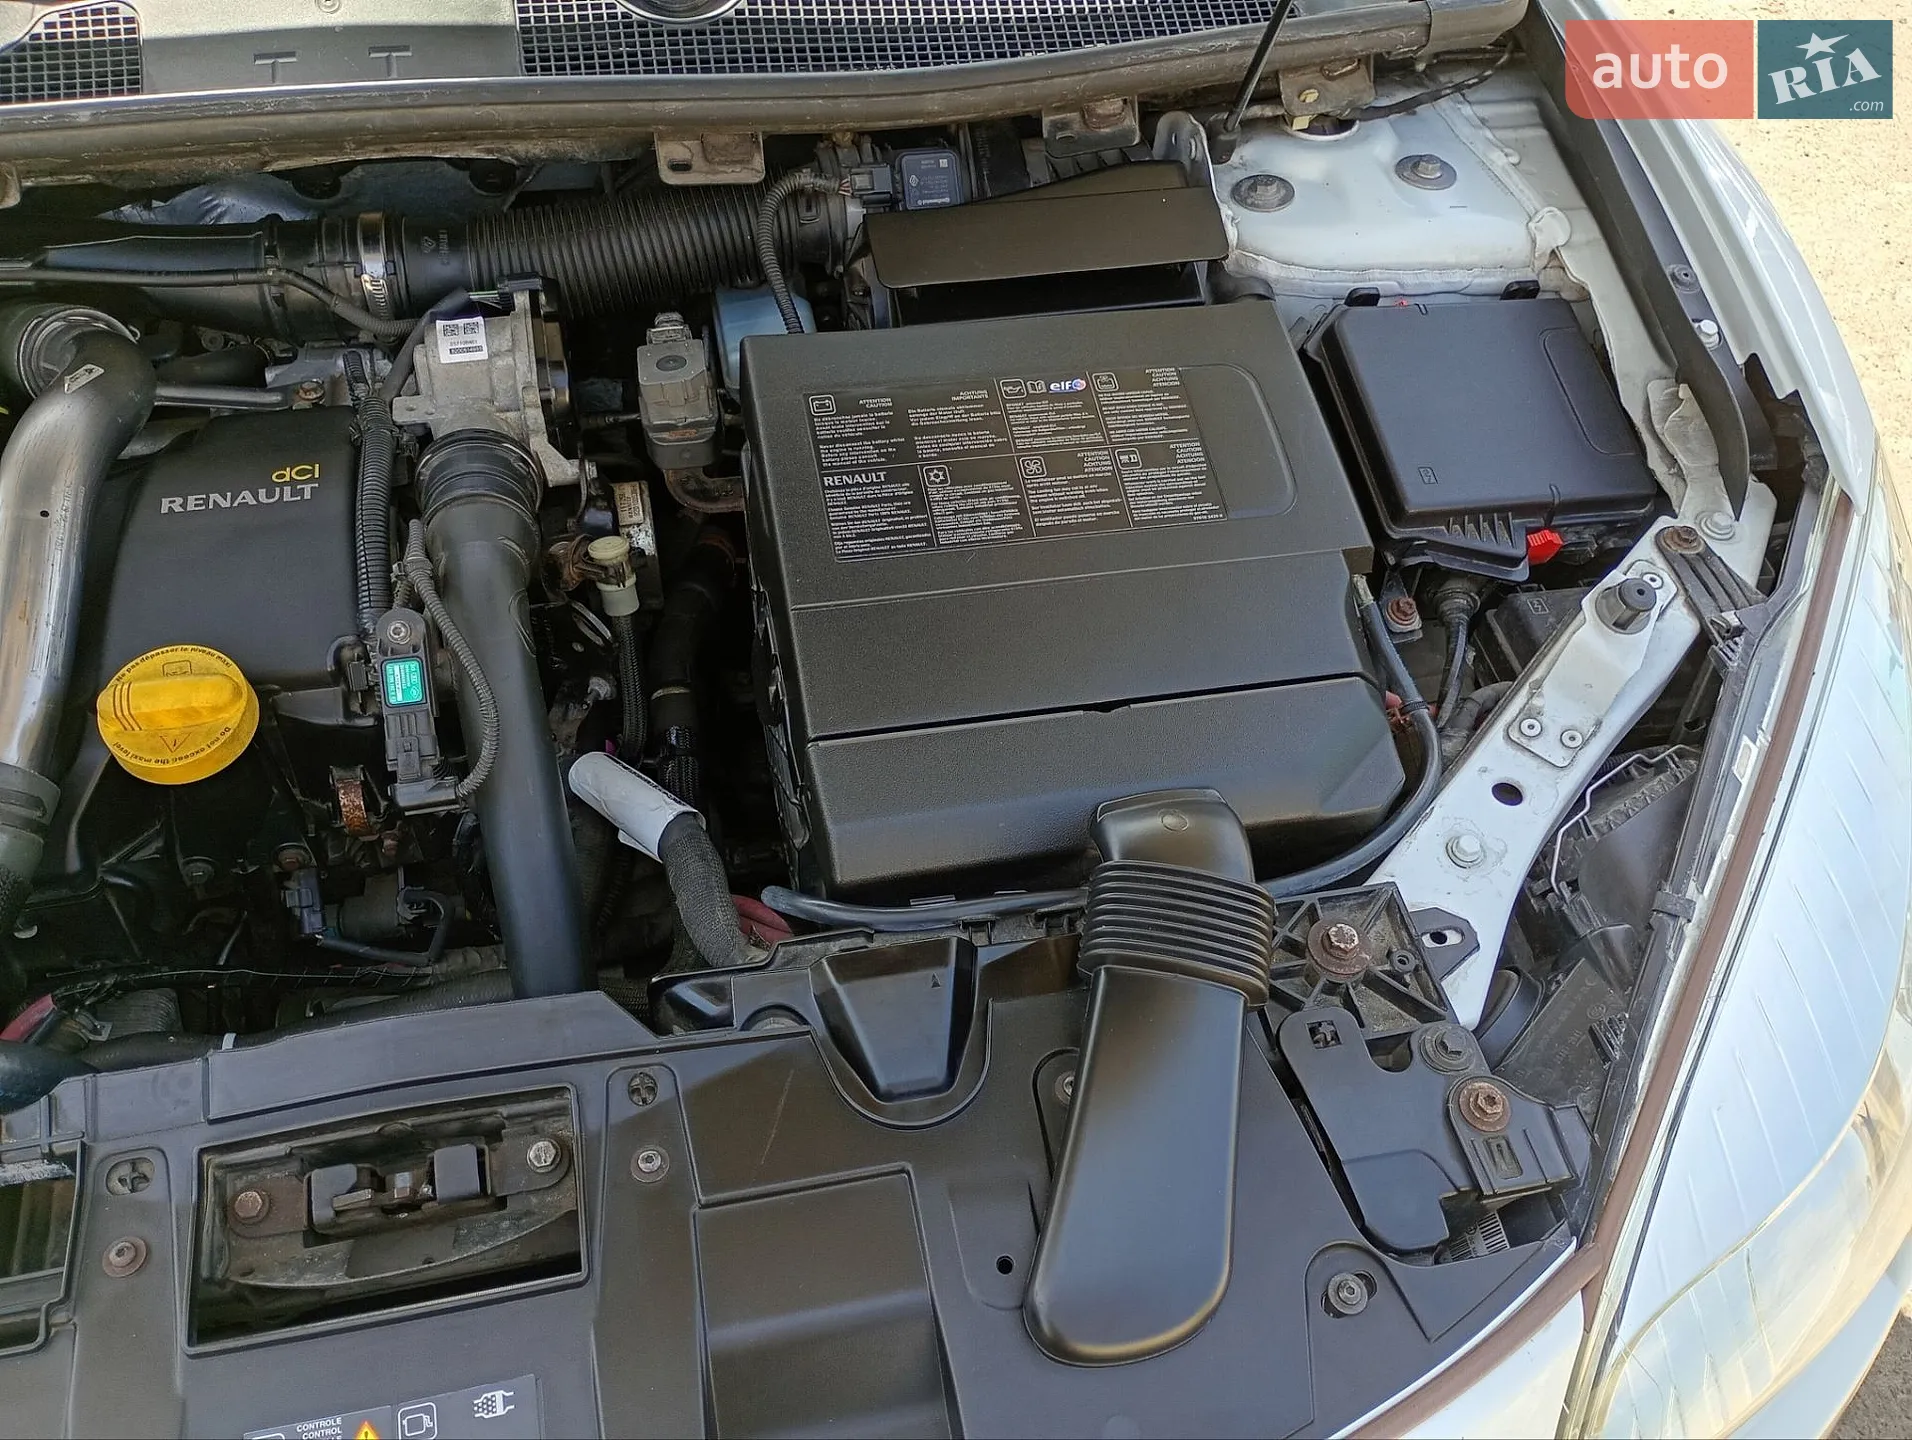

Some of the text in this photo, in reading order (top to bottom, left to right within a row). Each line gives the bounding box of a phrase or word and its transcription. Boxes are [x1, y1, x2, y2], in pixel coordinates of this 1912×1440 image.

[823, 471, 888, 487] RENAULT
[160, 483, 319, 514] RENAULT
[126, 662, 140, 673] pas
[190, 647, 216, 657] niveau
[215, 654, 233, 668] maxi
[220, 726, 231, 736] Do
[113, 742, 131, 757] level
[206, 736, 221, 748] not
[130, 754, 153, 763] maxi
[296, 1417, 342, 1432] CONTROLE
[302, 1426, 342, 1439] CONTROL
